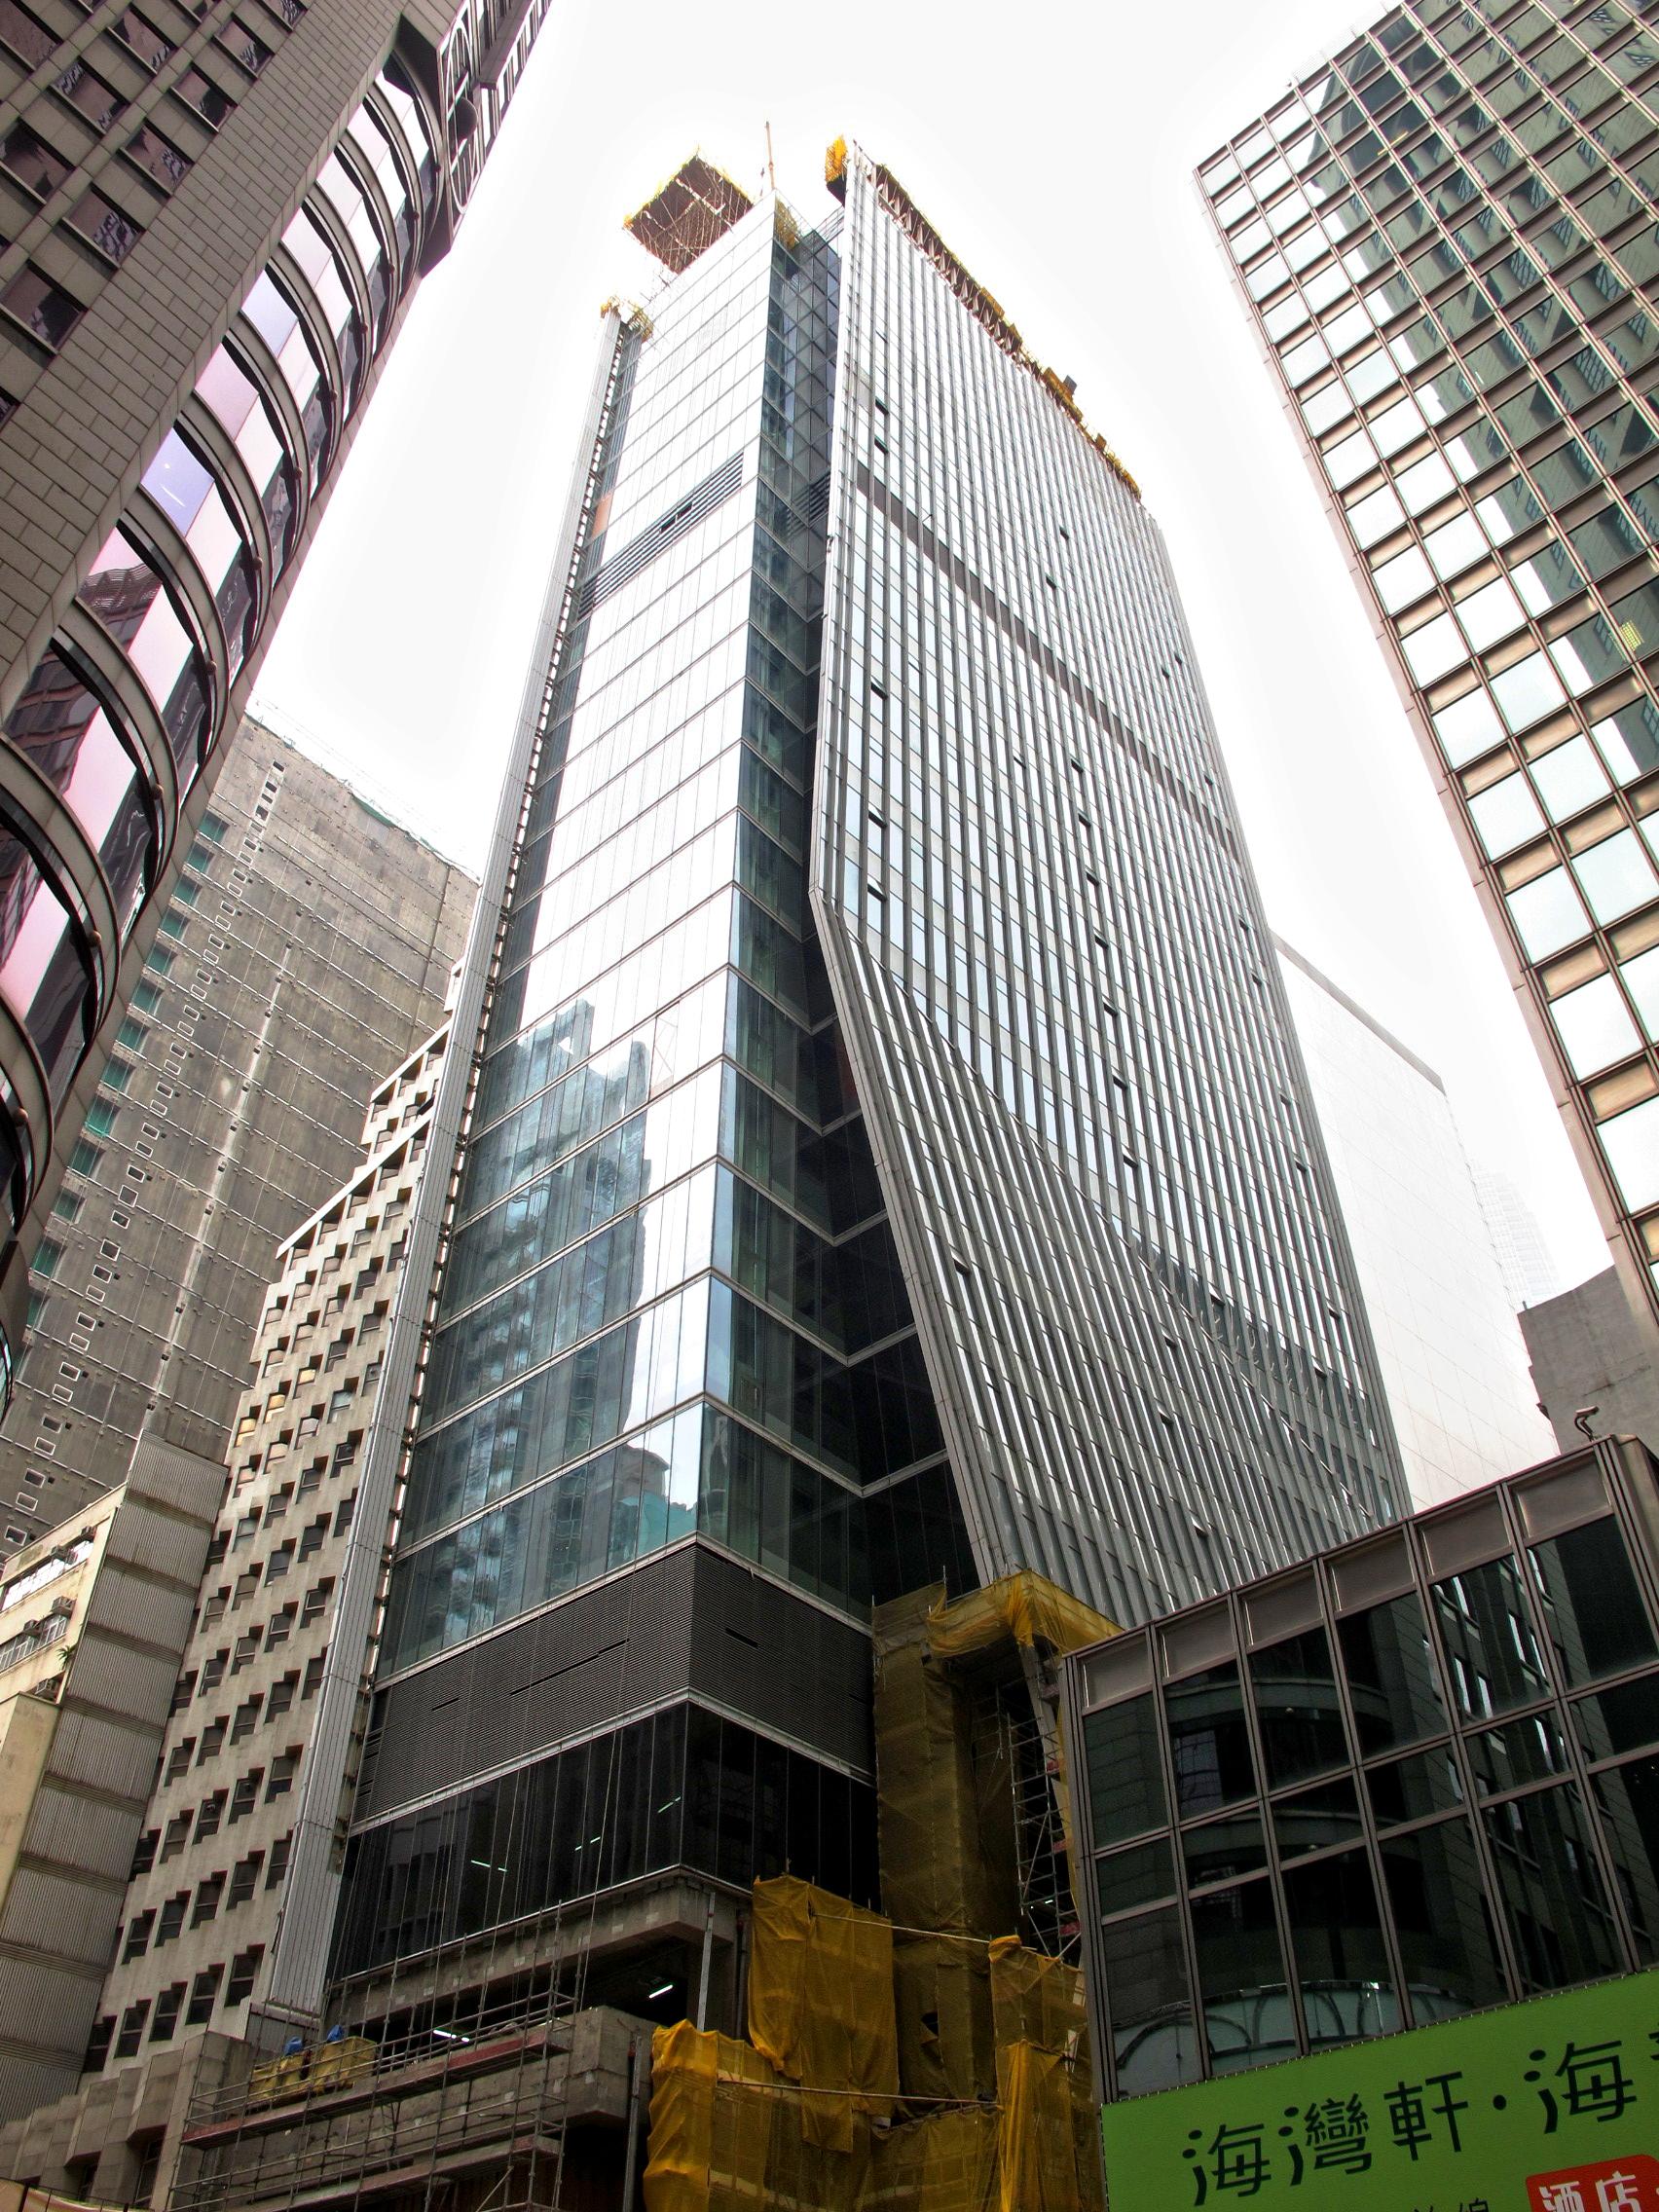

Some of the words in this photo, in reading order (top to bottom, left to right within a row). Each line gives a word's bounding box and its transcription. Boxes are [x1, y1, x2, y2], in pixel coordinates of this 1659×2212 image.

[1182, 2023, 1659, 2206] 海灣軒·海
[1538, 2170, 1659, 2212] 酒店
